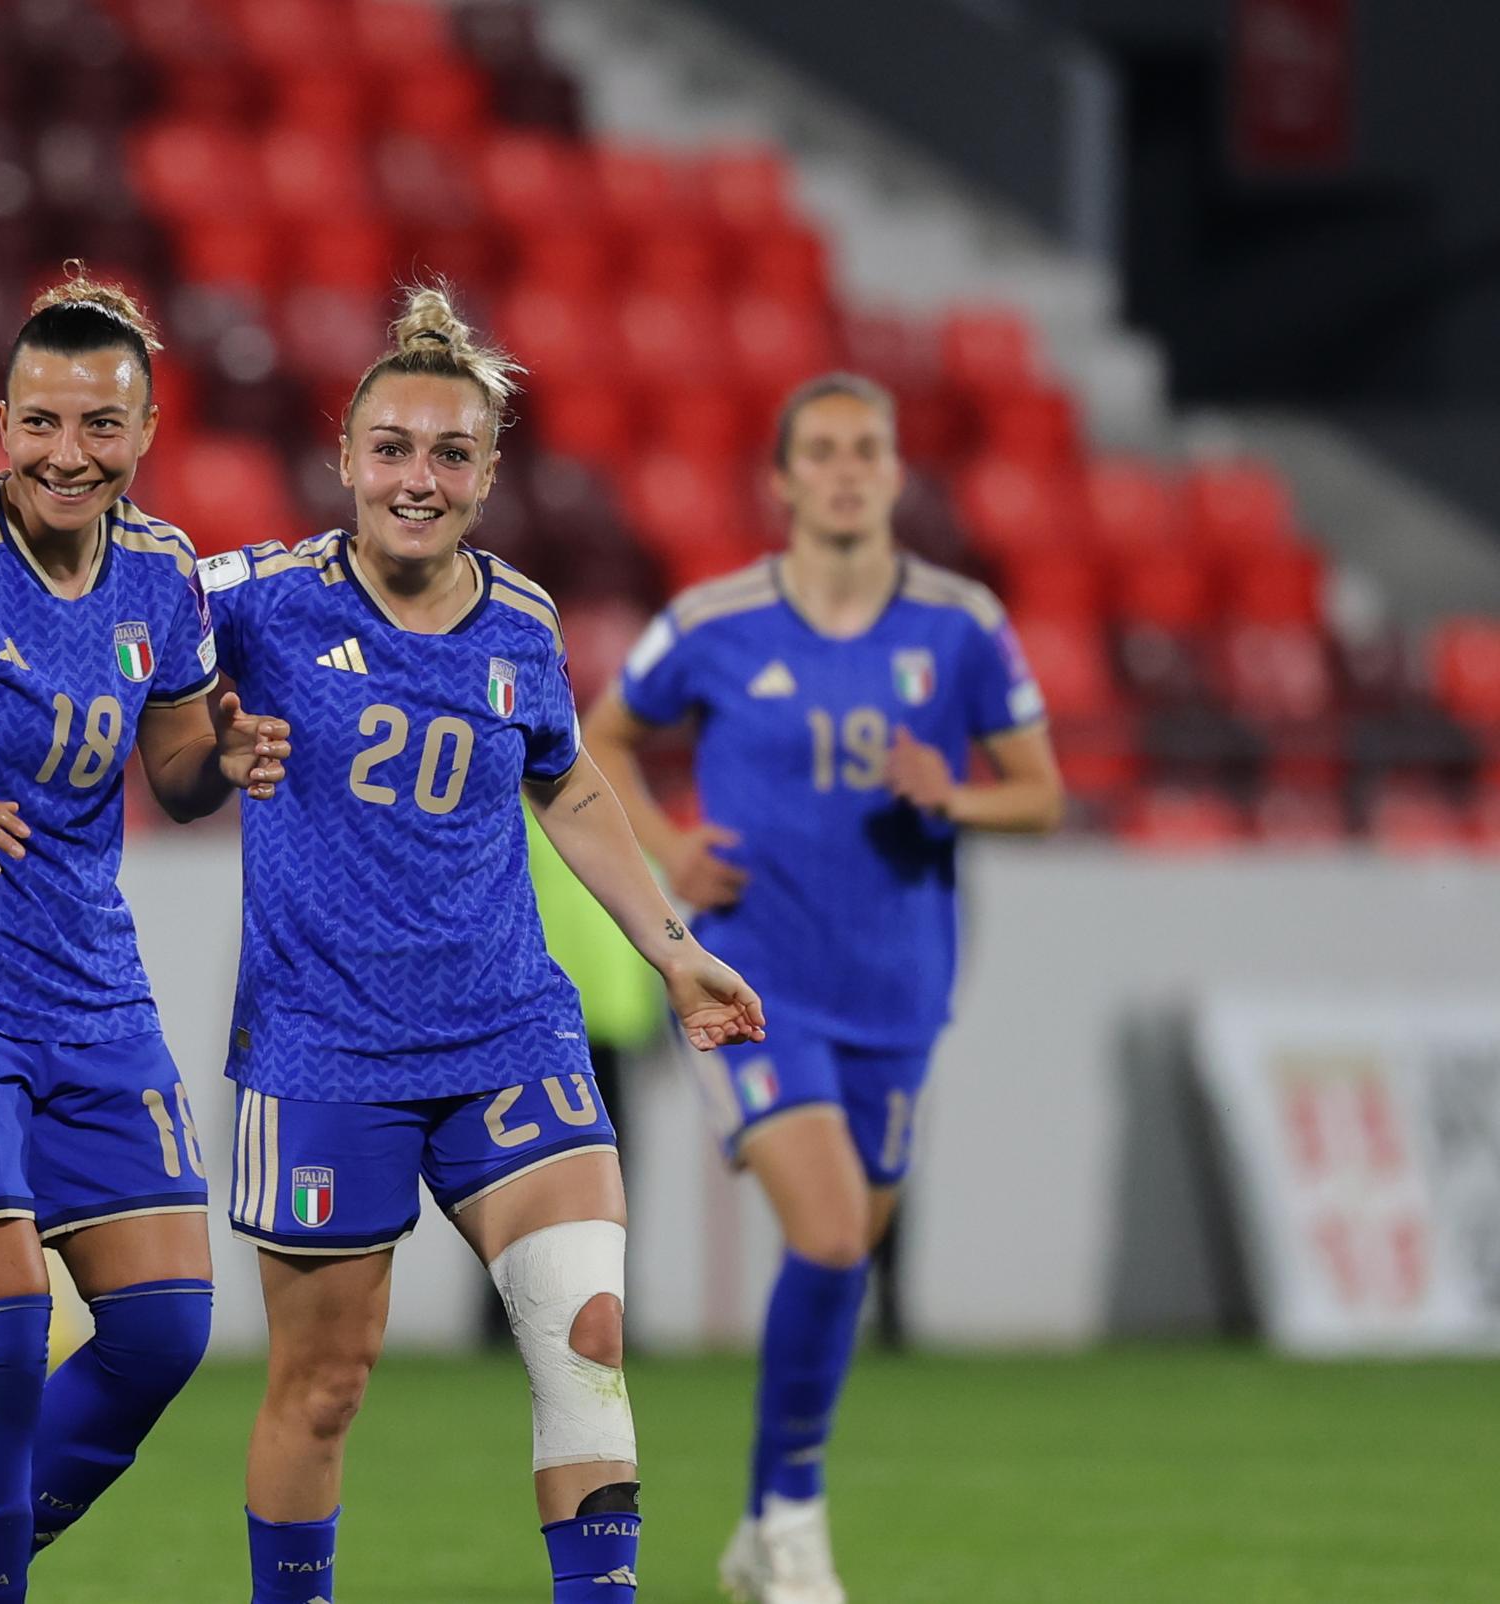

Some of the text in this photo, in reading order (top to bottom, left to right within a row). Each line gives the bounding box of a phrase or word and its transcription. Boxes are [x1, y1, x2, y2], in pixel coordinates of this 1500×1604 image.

[34, 692, 123, 789] 18
[348, 703, 476, 816] 20
[807, 706, 891, 793] 19
[295, 1170, 330, 1184] ITALIA
[582, 1522, 640, 1537] ITALIA
